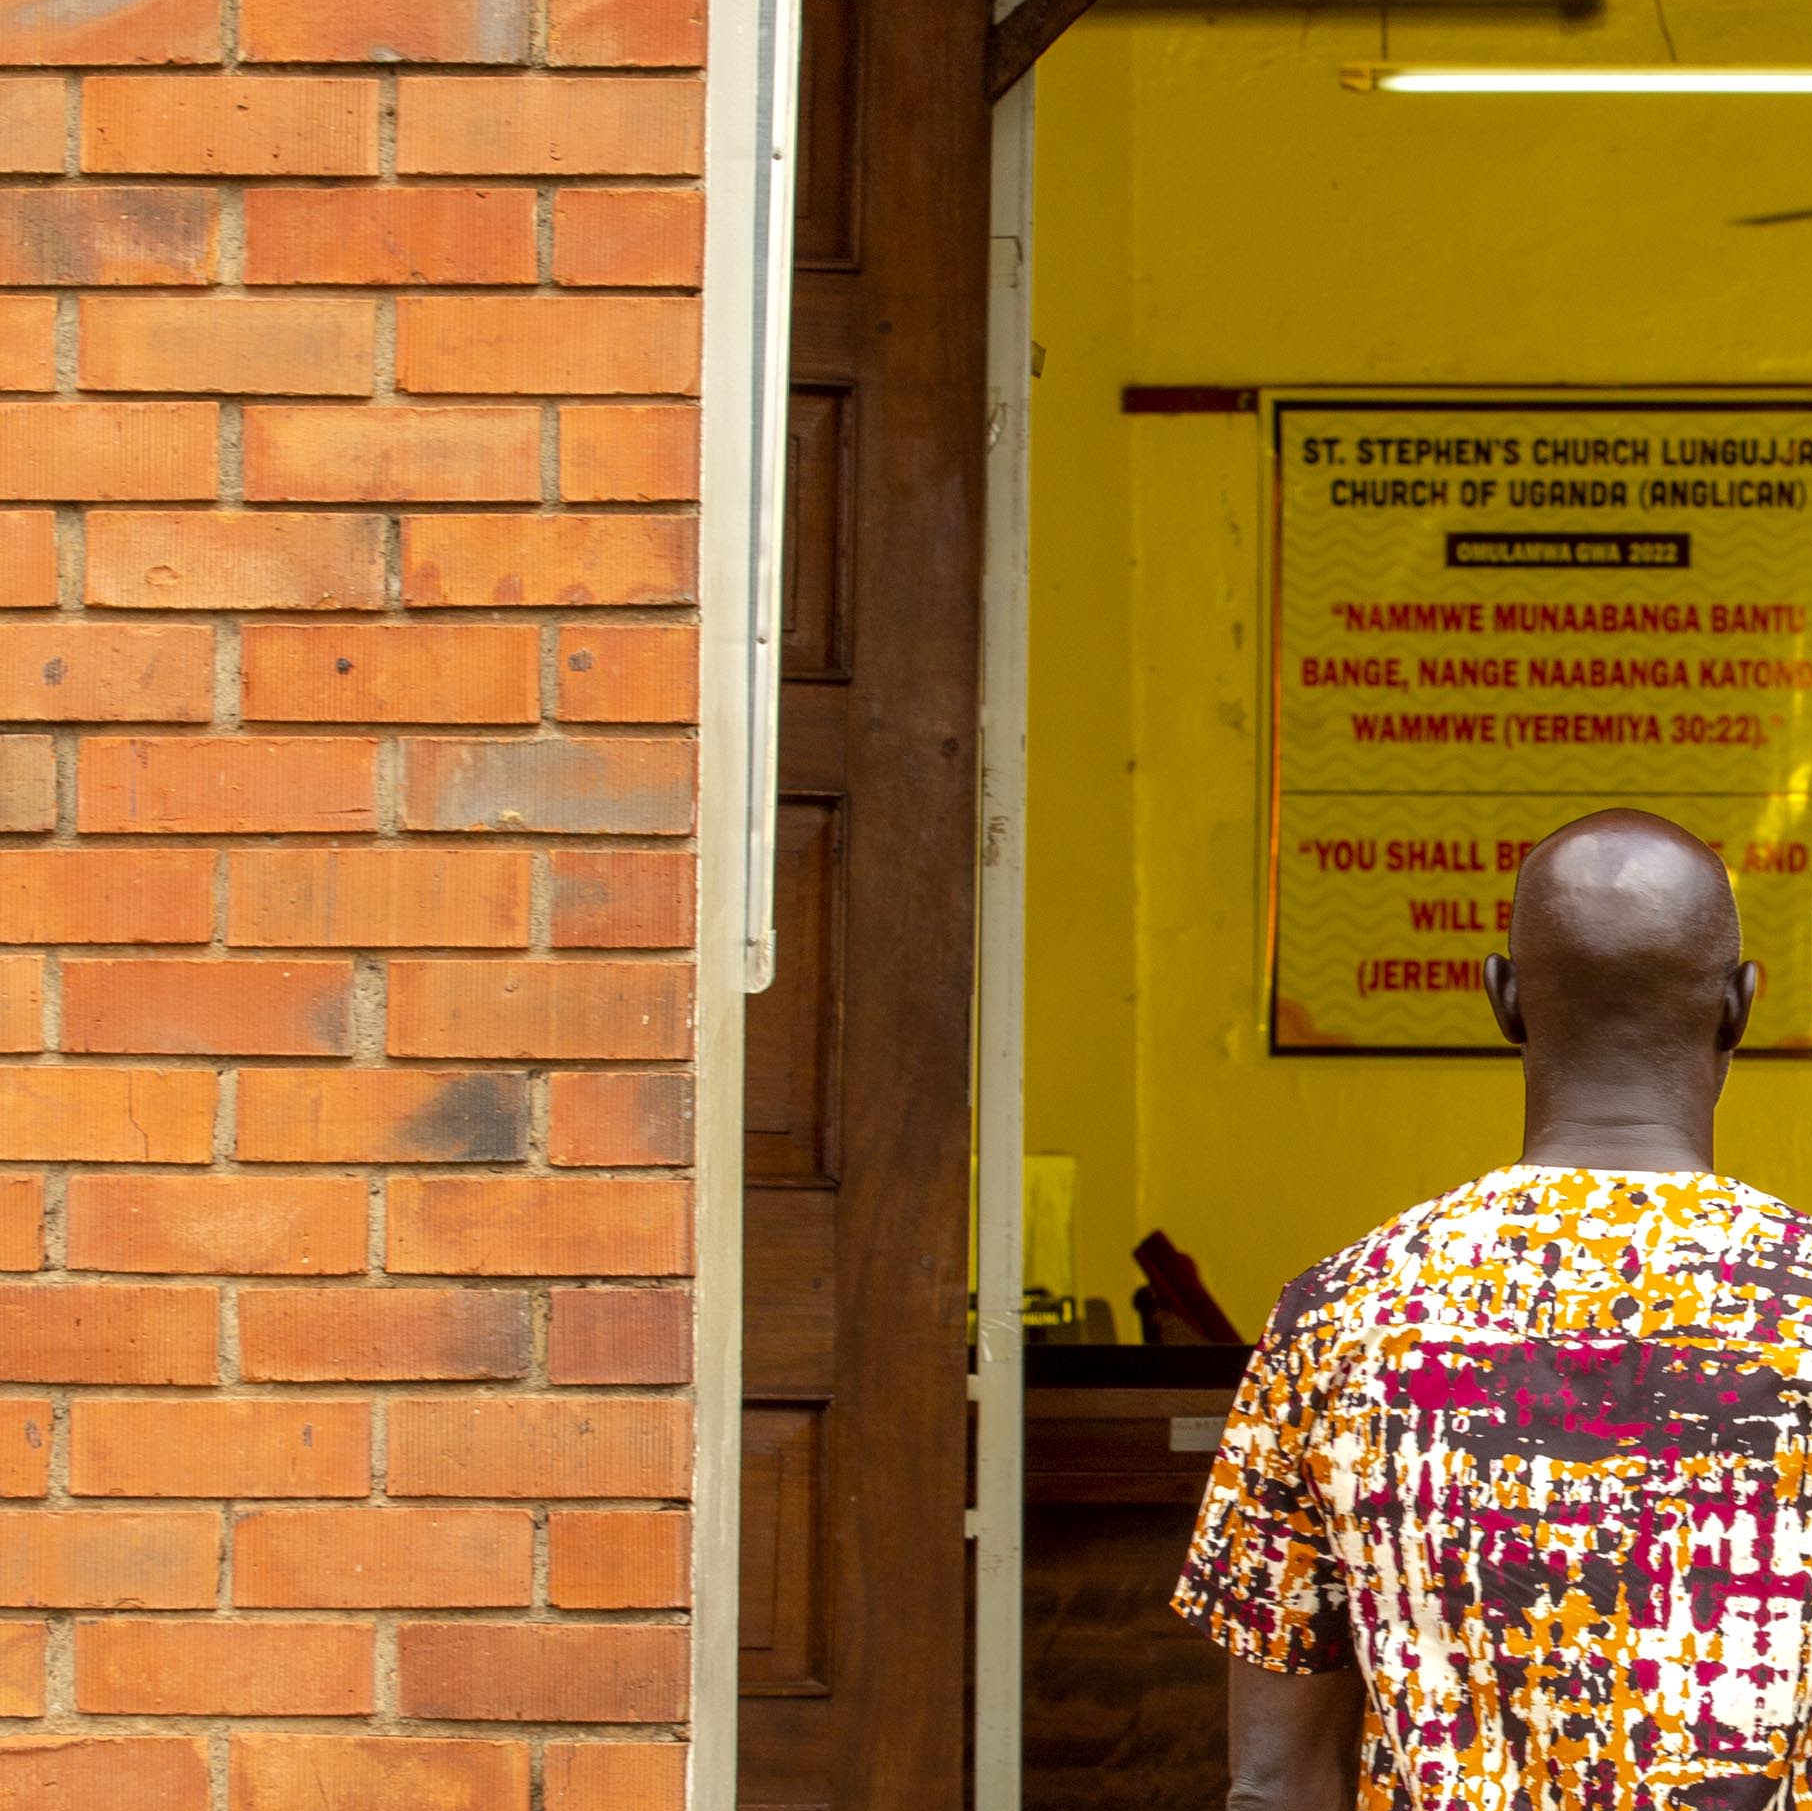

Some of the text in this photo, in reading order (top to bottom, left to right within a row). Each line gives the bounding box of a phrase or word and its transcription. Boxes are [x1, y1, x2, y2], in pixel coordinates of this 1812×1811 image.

[1302, 438, 1346, 466] ST.
[1356, 438, 1521, 466] STEPHEN'S
[1532, 438, 1650, 466] CHURCH
[1331, 478, 1808, 511] CHURCH OF UGANDA (ANGLICAN)
[1627, 541, 1679, 564] 2022
[1494, 603, 1701, 633] MUNAABANGA
[1710, 603, 1806, 633] BANTU
[1301, 658, 1409, 692] BANGE,
[1418, 659, 1519, 688] NANGE
[1528, 659, 1690, 688] NAABANGA
[1352, 714, 1497, 744] WAMMWE
[1503, 714, 1662, 748] (YEREMIYA
[1385, 840, 1487, 872] SHALL
[1741, 841, 1808, 874] AND
[1407, 899, 1485, 932] WILL
[1356, 959, 1483, 998] (JEREMI
